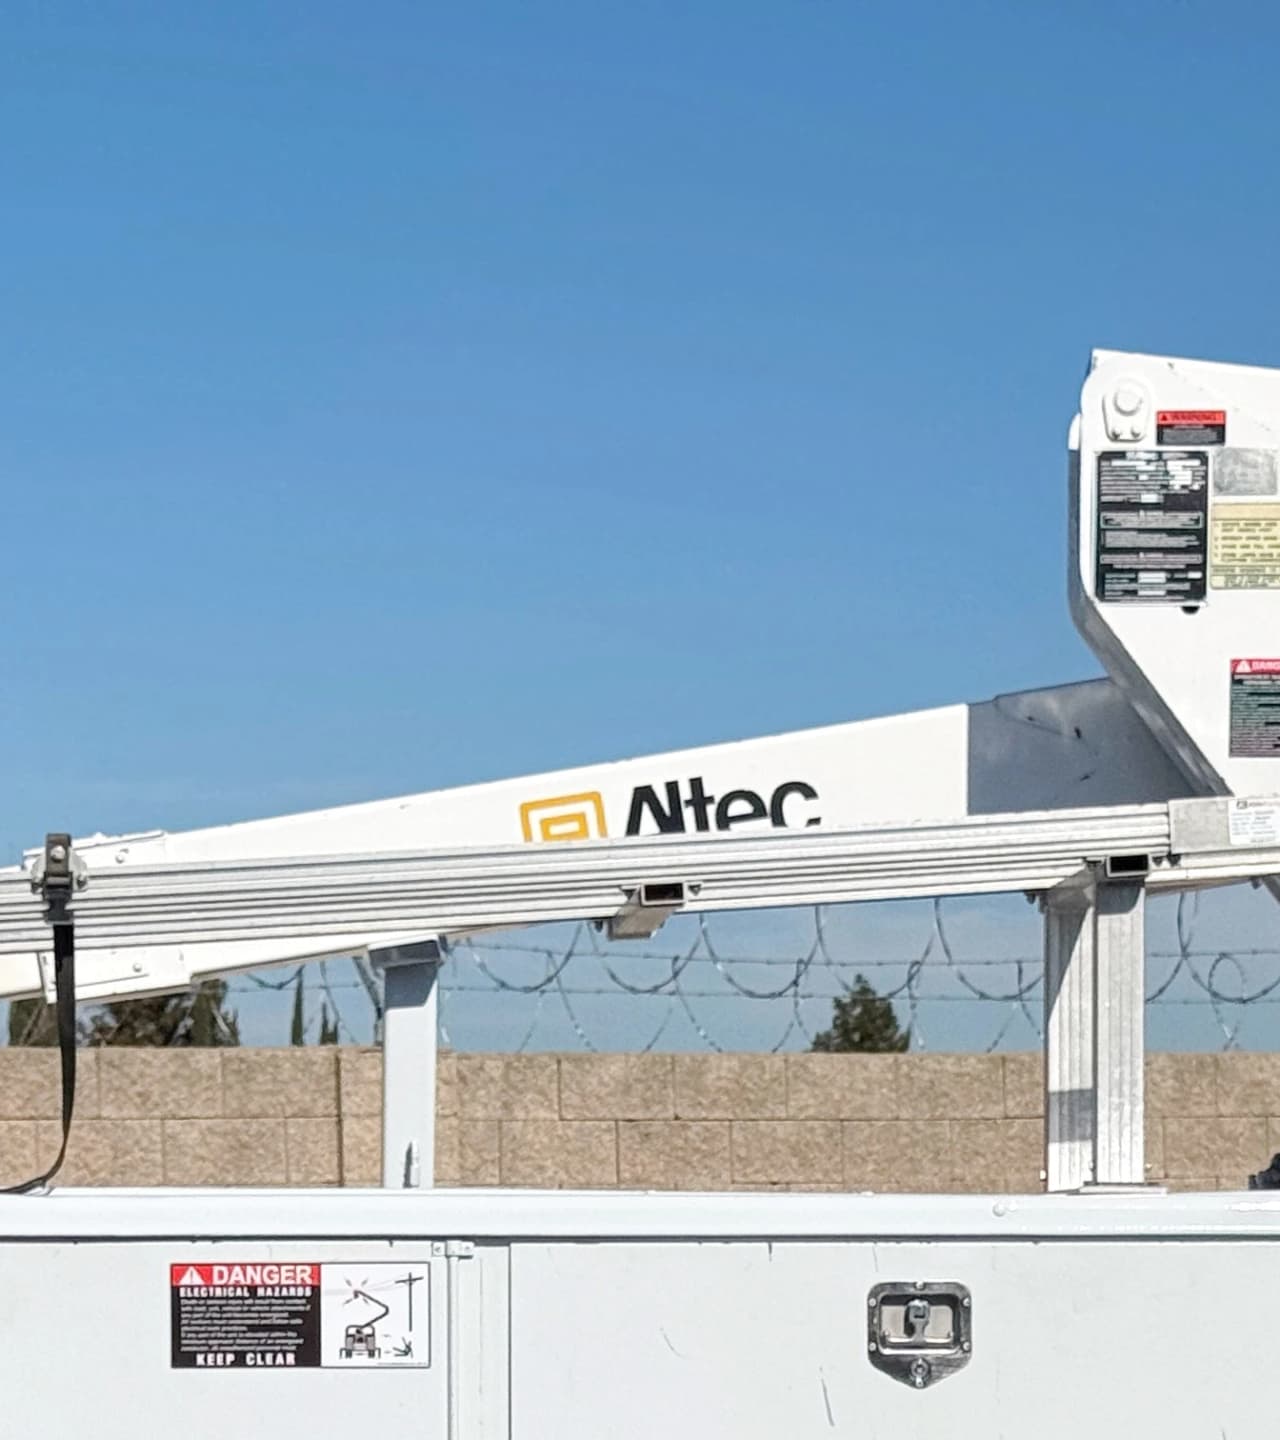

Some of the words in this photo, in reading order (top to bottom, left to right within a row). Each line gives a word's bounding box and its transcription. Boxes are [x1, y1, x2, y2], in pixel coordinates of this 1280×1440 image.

[625, 776, 822, 837] Altec
[212, 1265, 312, 1286] DANGER
[179, 1286, 251, 1298] ELECTRICAL
[256, 1286, 312, 1298] HAZARDS
[196, 1352, 236, 1366] KEEP
[245, 1352, 297, 1367] CLEAR
